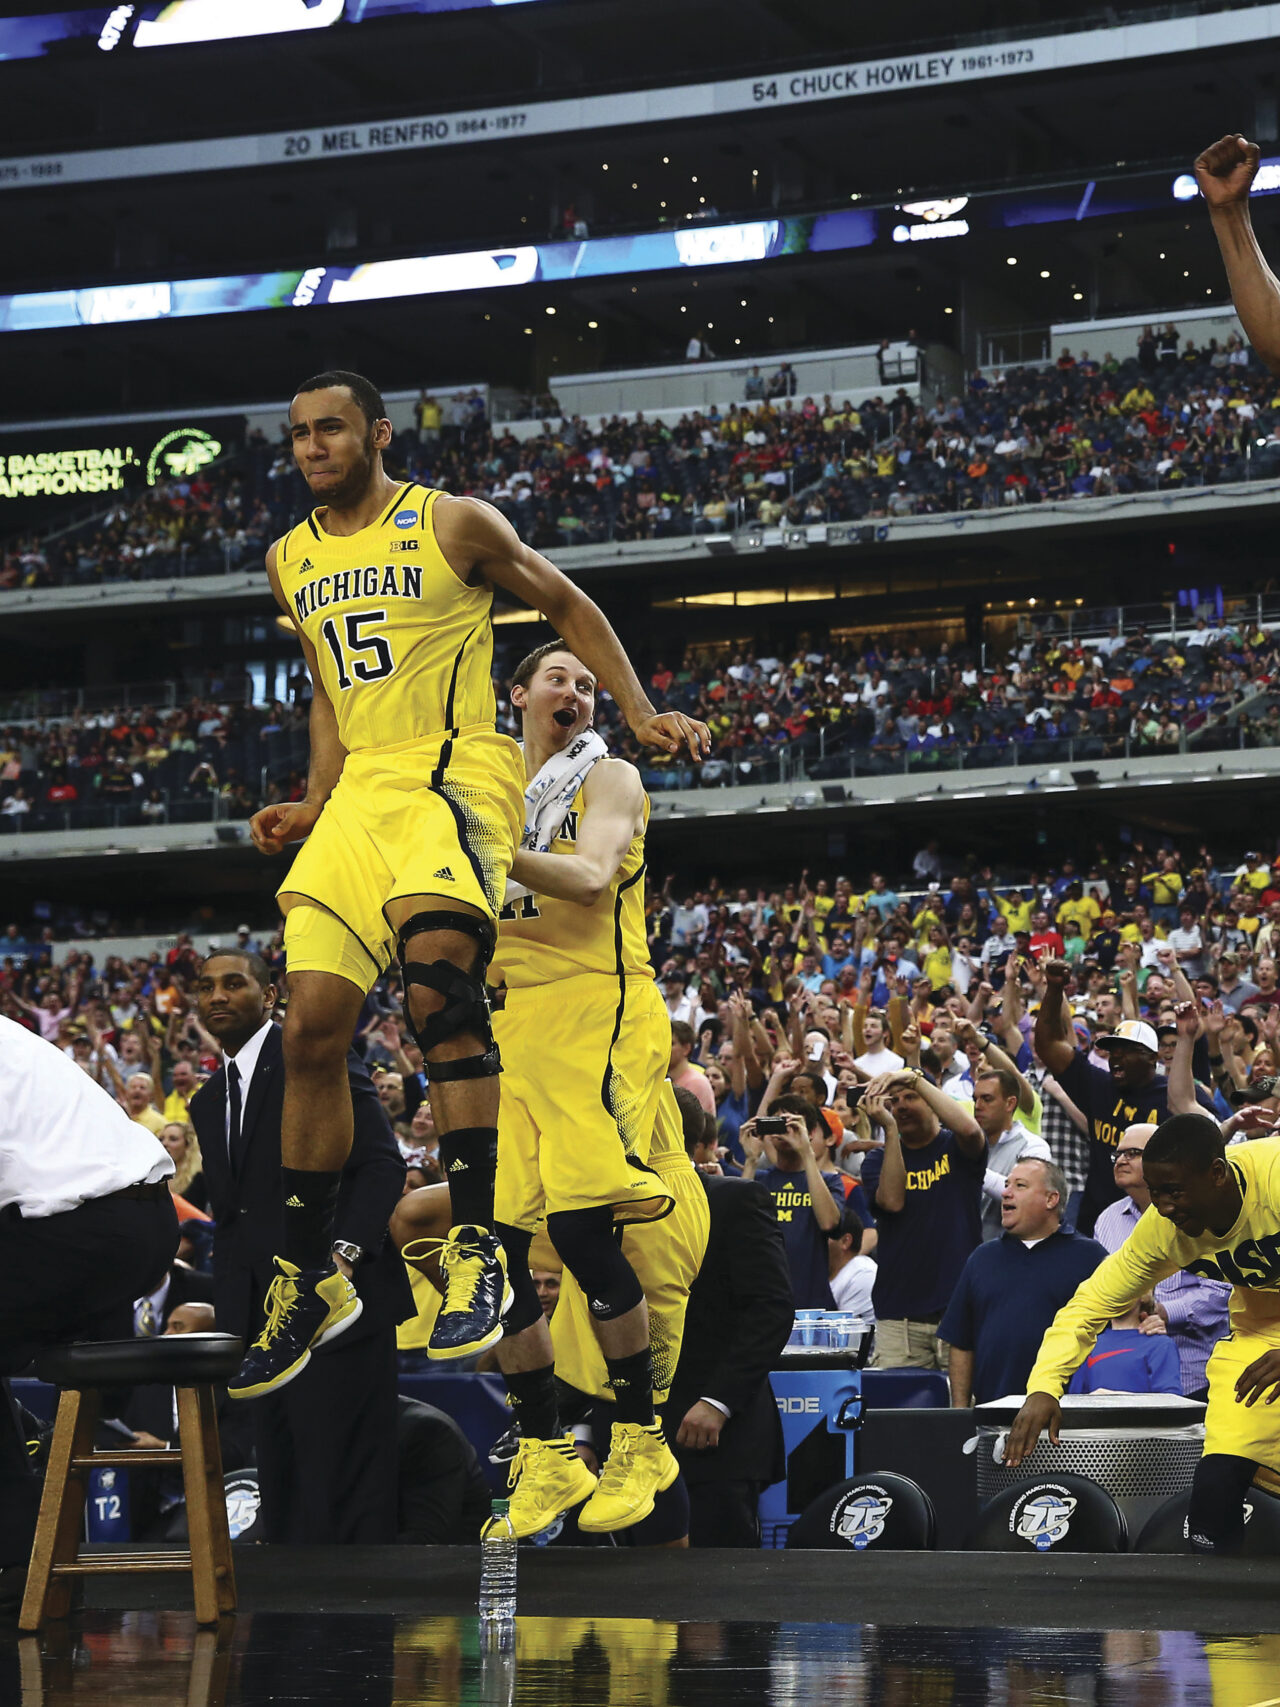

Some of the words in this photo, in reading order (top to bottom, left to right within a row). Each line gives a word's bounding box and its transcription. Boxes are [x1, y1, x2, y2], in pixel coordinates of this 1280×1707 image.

[752, 81, 778, 102] 54
[789, 70, 859, 97] CHUCK
[866, 57, 955, 86] HOWLEY
[962, 48, 1035, 71] 1961-1973
[284, 136, 311, 156] 20
[321, 132, 361, 152] MEL
[368, 121, 450, 147] RENFRO
[293, 565, 423, 624] MICHIGAN
[322, 609, 395, 691] 15
[566, 739, 589, 760] NCAA
[771, 1191, 811, 1208] HIGA
[94, 1495, 121, 1521] T2
[1025, 1484, 1046, 1496] MARCH
[843, 1504, 886, 1541] 75
[1022, 1504, 1070, 1541] 75
